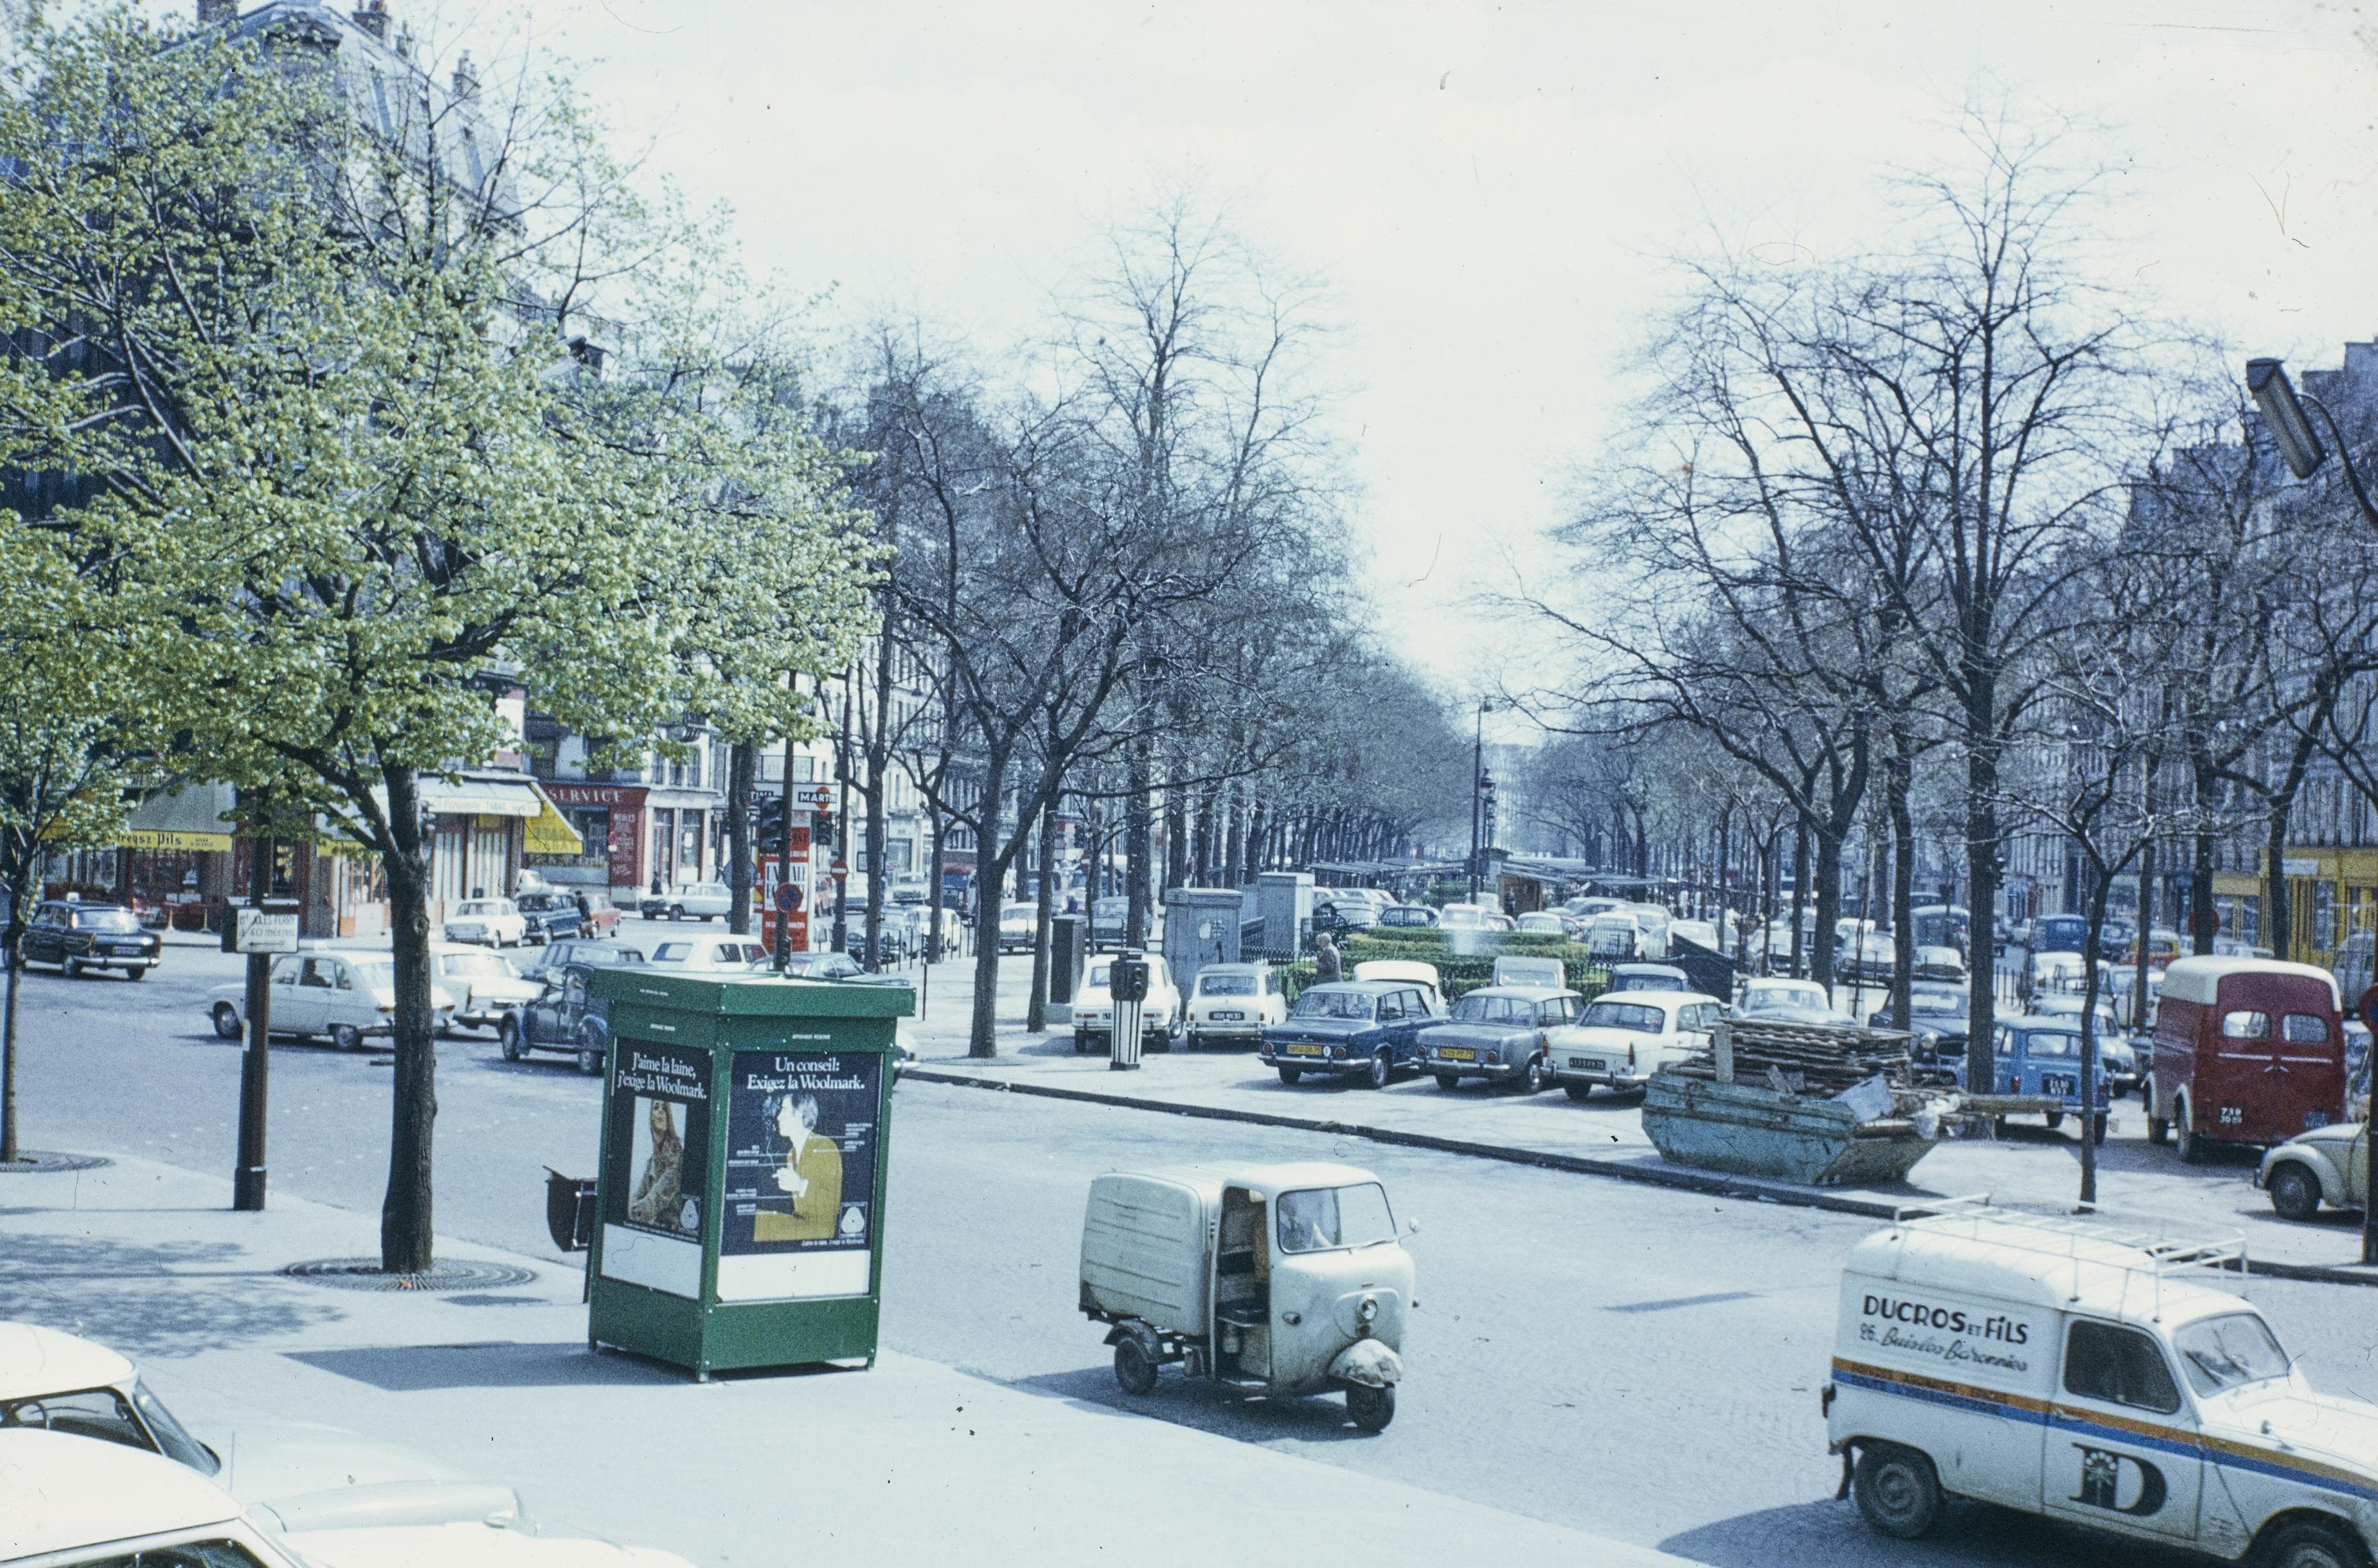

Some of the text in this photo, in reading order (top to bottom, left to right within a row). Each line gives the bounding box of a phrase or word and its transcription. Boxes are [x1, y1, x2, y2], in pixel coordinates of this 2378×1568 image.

[548, 788, 622, 803] SERVICE
[157, 833, 183, 846] Pils
[632, 1052, 696, 1080] J'aime la laine,
[774, 1056, 840, 1072] Un conseil:
[618, 1069, 708, 1099] j'exige la Woolmark.
[747, 1074, 865, 1092] Exigez la Woolmark.
[1863, 1295, 1967, 1332] DUCROS
[1967, 1324, 1983, 1337] ET
